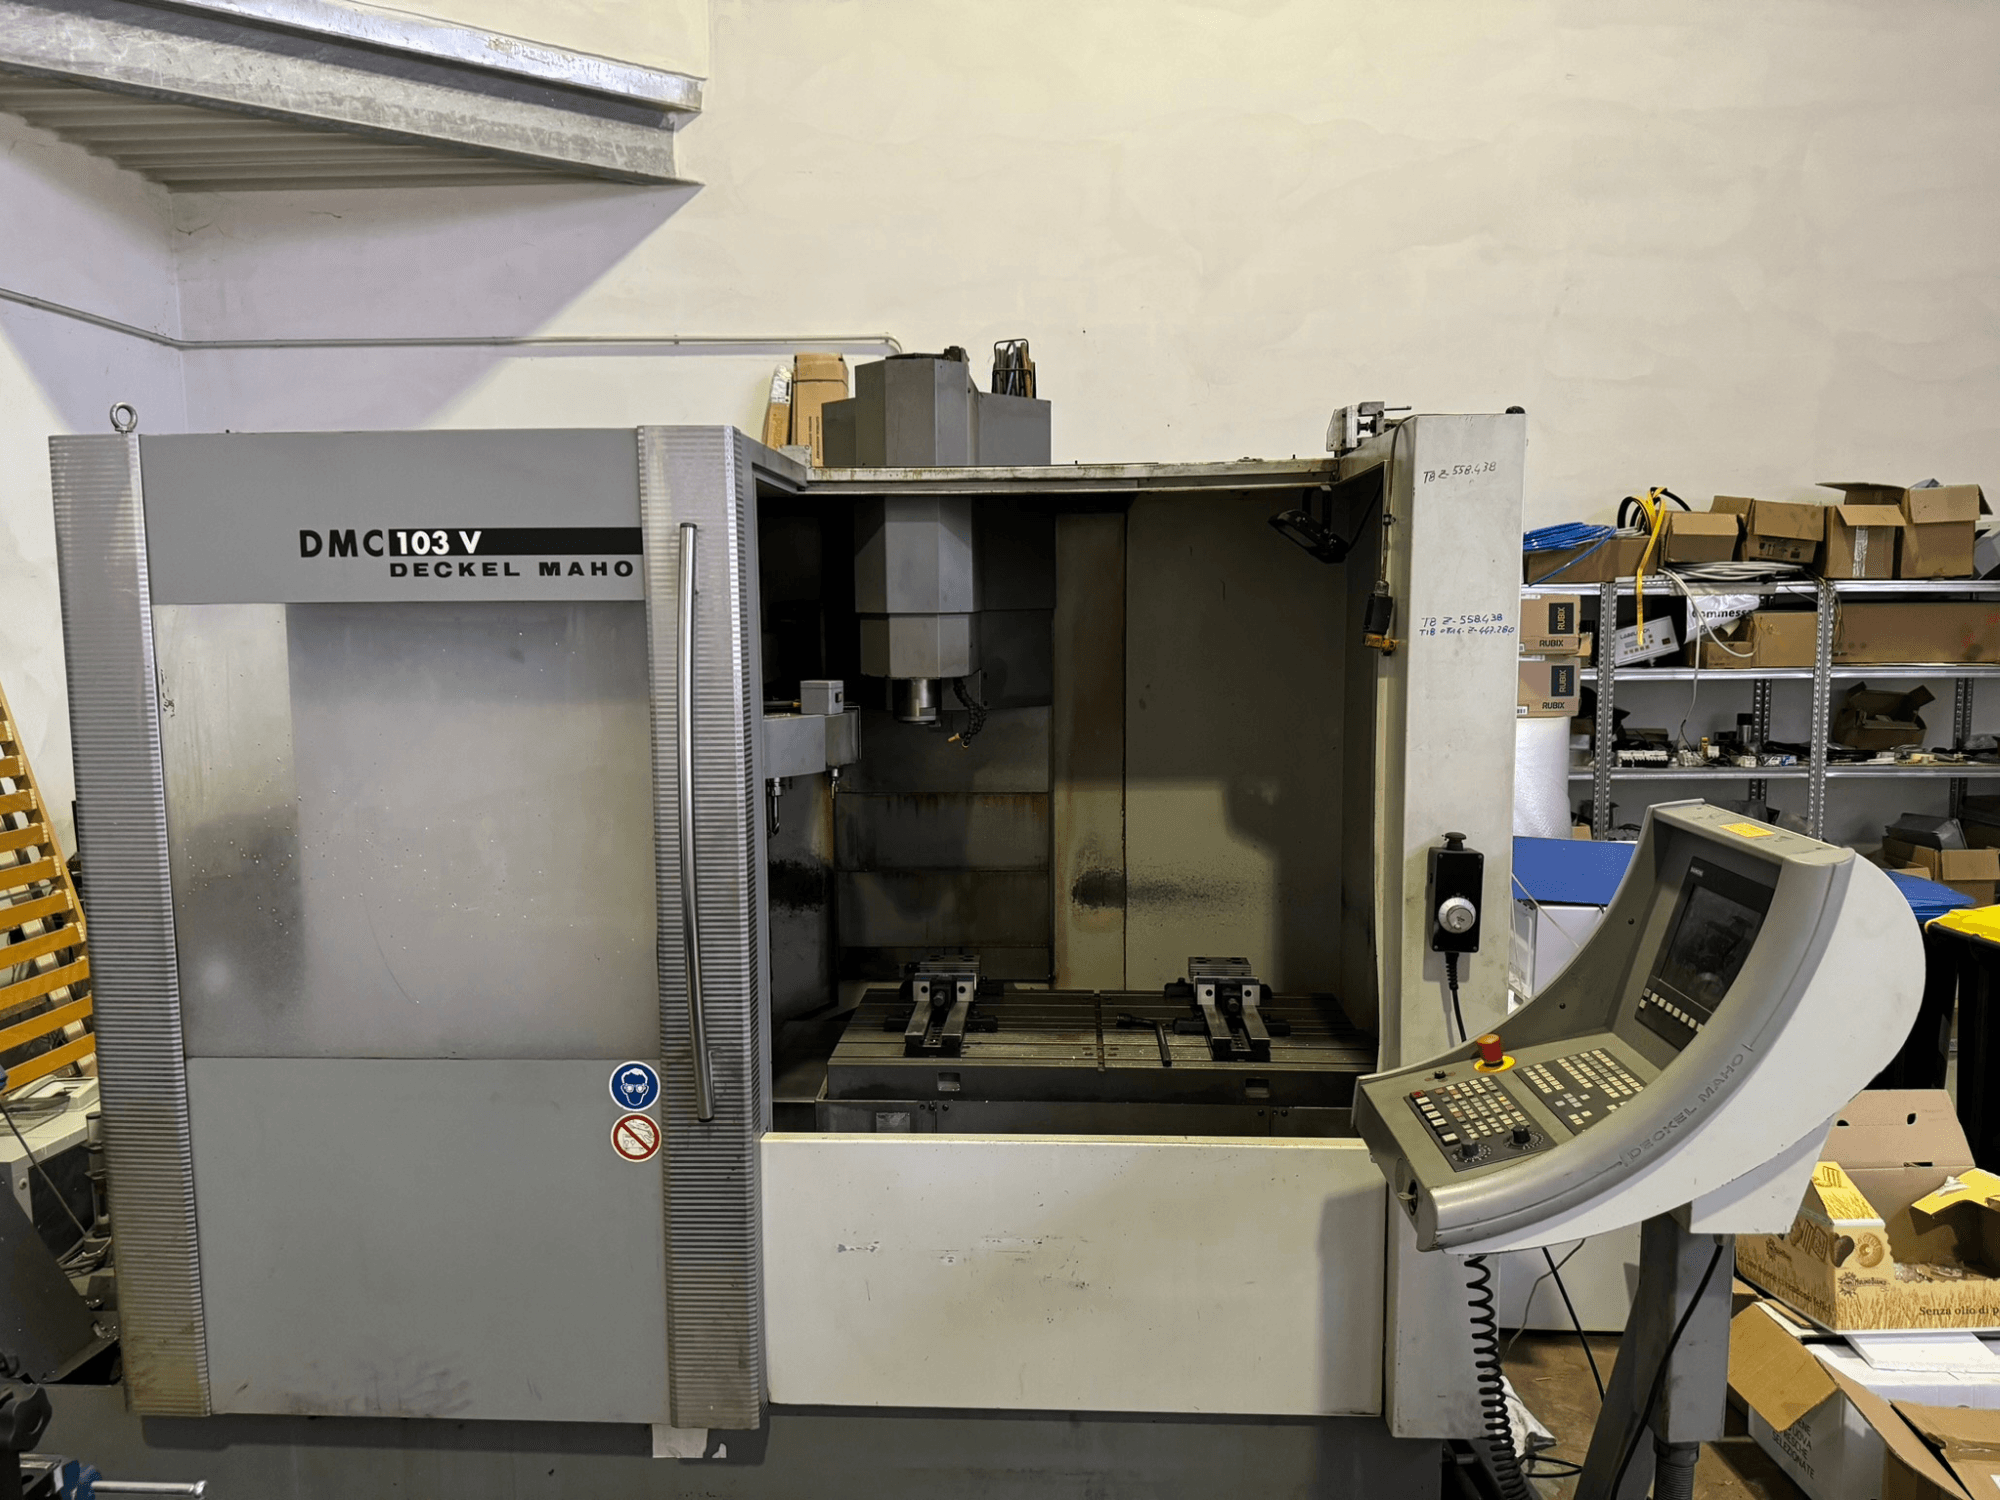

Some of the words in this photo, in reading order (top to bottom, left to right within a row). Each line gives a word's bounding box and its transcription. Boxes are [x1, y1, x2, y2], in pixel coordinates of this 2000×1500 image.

[299, 529, 384, 558] DMC
[397, 530, 450, 556] 103
[458, 530, 483, 554] V
[390, 561, 521, 578] DECKEL
[538, 560, 634, 578] MAHO
[1557, 606, 1566, 631] RUBIX
[1539, 639, 1564, 647] RUBIX
[1558, 669, 1567, 693] RUBIX
[1541, 701, 1566, 710] RUBIX
[1627, 1107, 1697, 1160] DECKEL
[1698, 1053, 1744, 1103] MAHO
[1918, 1306, 1952, 1317] Senza
[1954, 1305, 1977, 1316] olio
[1978, 1305, 1989, 1315] di
[1772, 1430, 1815, 1480] SELEZIONATE
